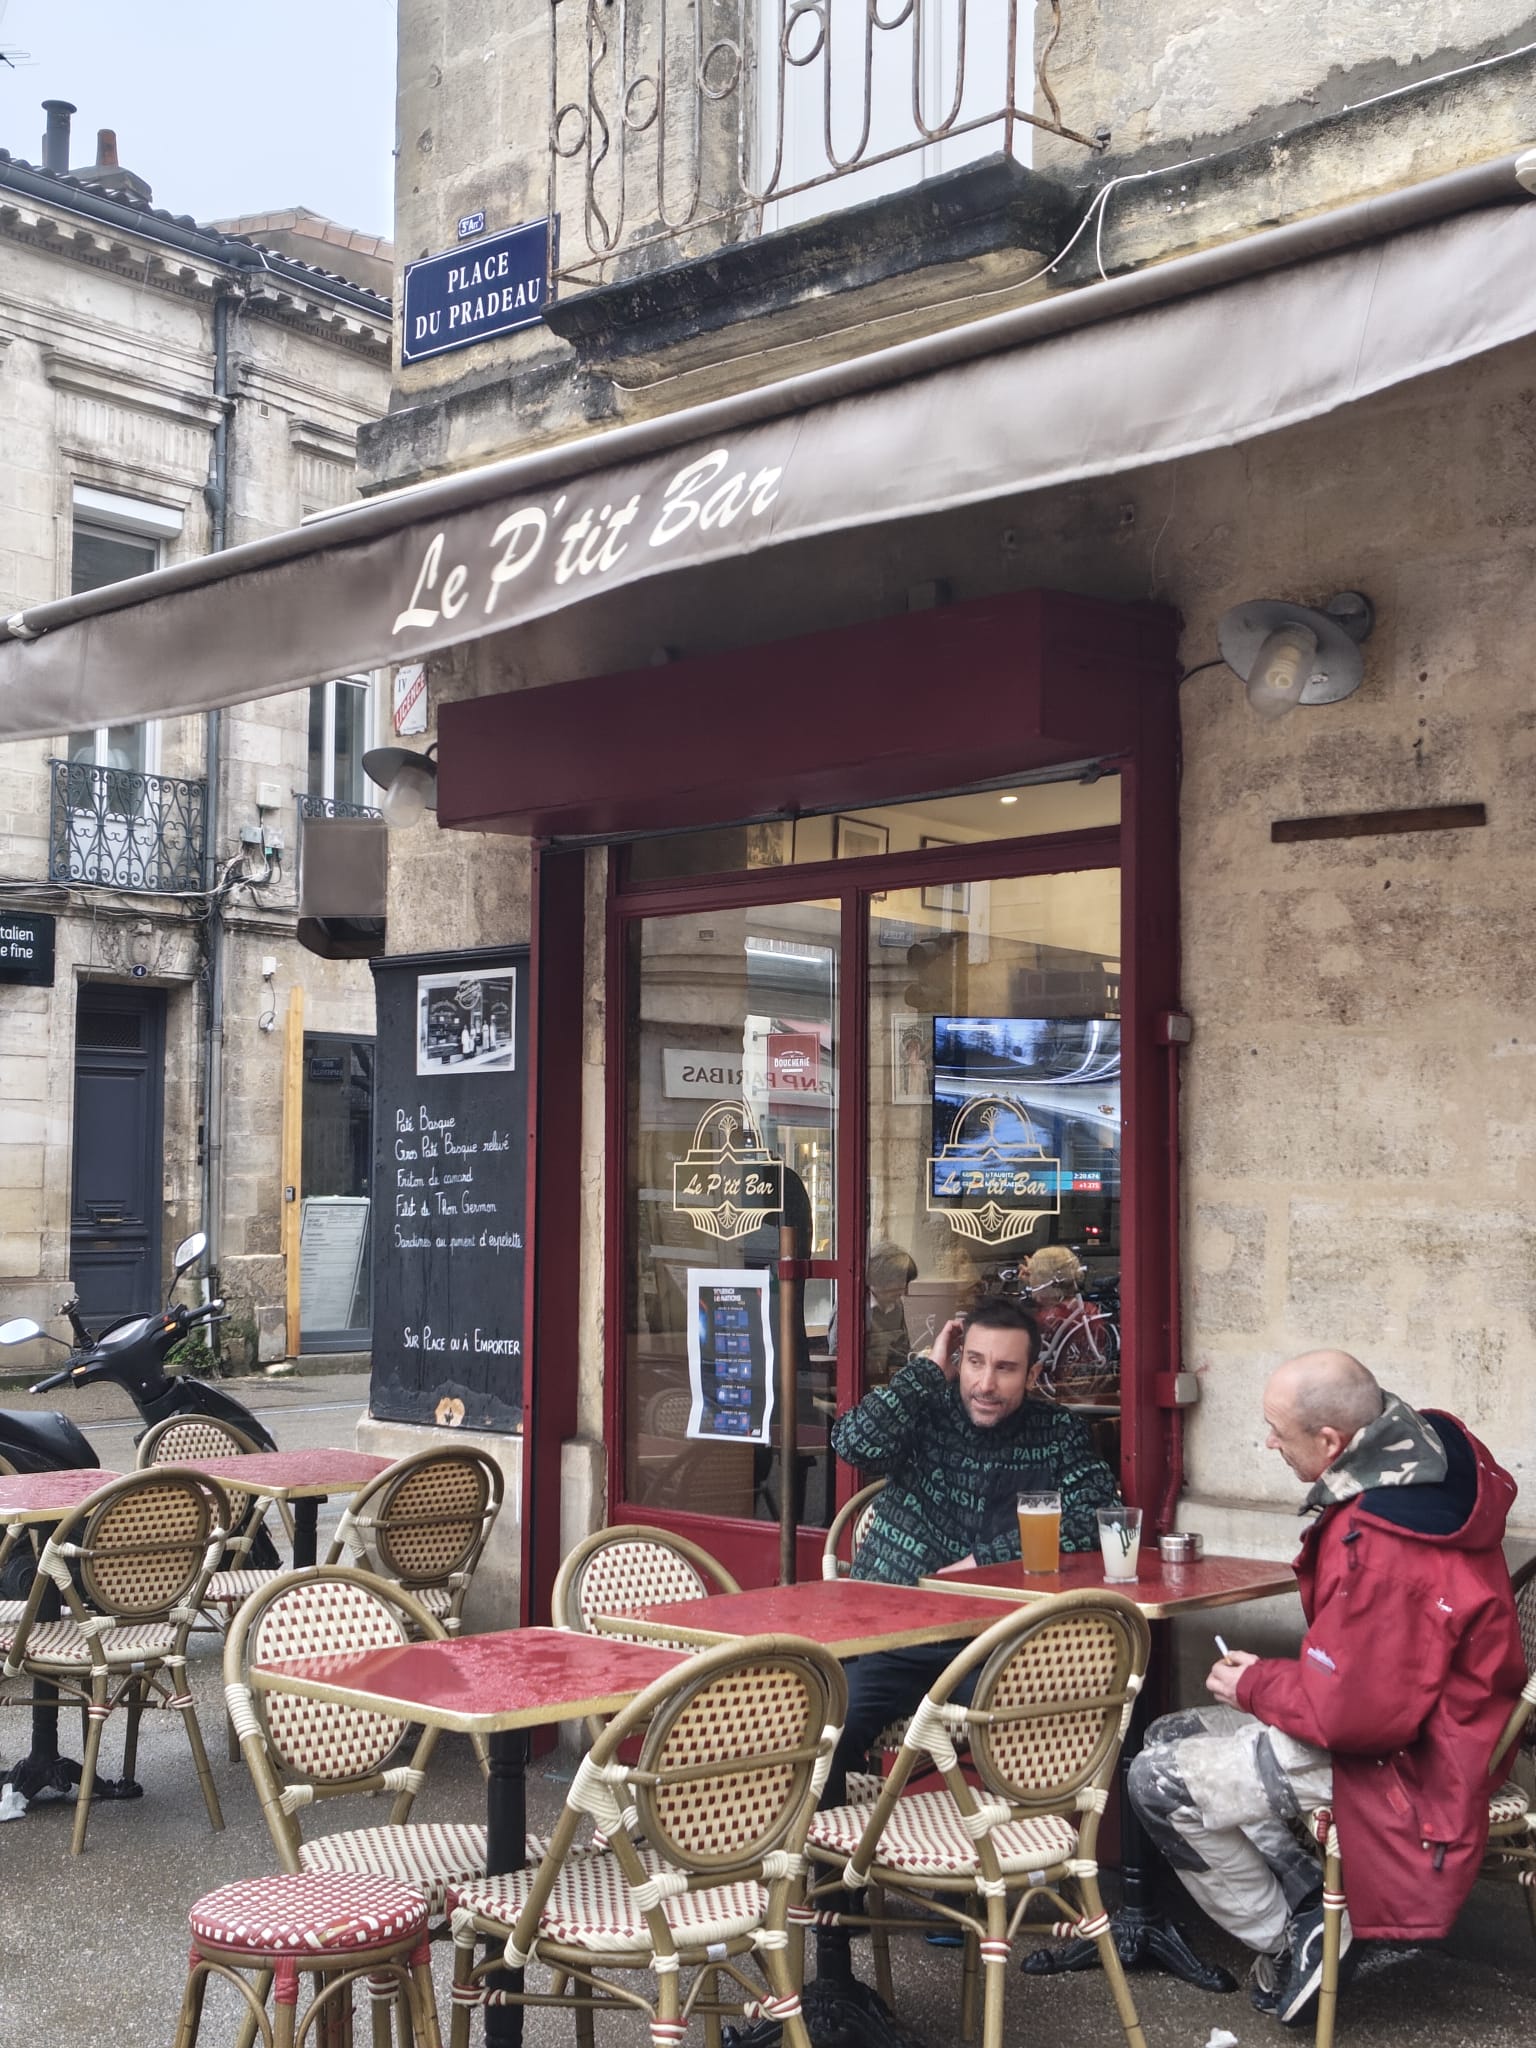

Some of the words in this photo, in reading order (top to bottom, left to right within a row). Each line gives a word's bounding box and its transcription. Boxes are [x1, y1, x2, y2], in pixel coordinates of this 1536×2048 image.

[448, 251, 510, 294] PLACE
[415, 309, 441, 340] DU
[449, 278, 542, 329] PRADEAU
[392, 533, 469, 635] Le
[485, 494, 641, 615] P'tit
[649, 448, 782, 548] Bar
[10, 942, 33, 958] fine
[774, 1056, 810, 1068] BOUCHERIE
[420, 1105, 456, 1138] Basque
[444, 1132, 478, 1161] Basque
[428, 1166, 439, 1186] de
[443, 1166, 474, 1184] canard
[683, 1173, 702, 1195] Le
[706, 1173, 741, 1196] P'tit
[745, 1173, 774, 1195] Bar
[939, 1171, 961, 1196] Le
[967, 1172, 1006, 1196] P'tit
[1013, 1171, 1048, 1196] Bar
[435, 1191, 458, 1215] Thon
[461, 1190, 497, 1213] Germon
[435, 1237, 447, 1248] au
